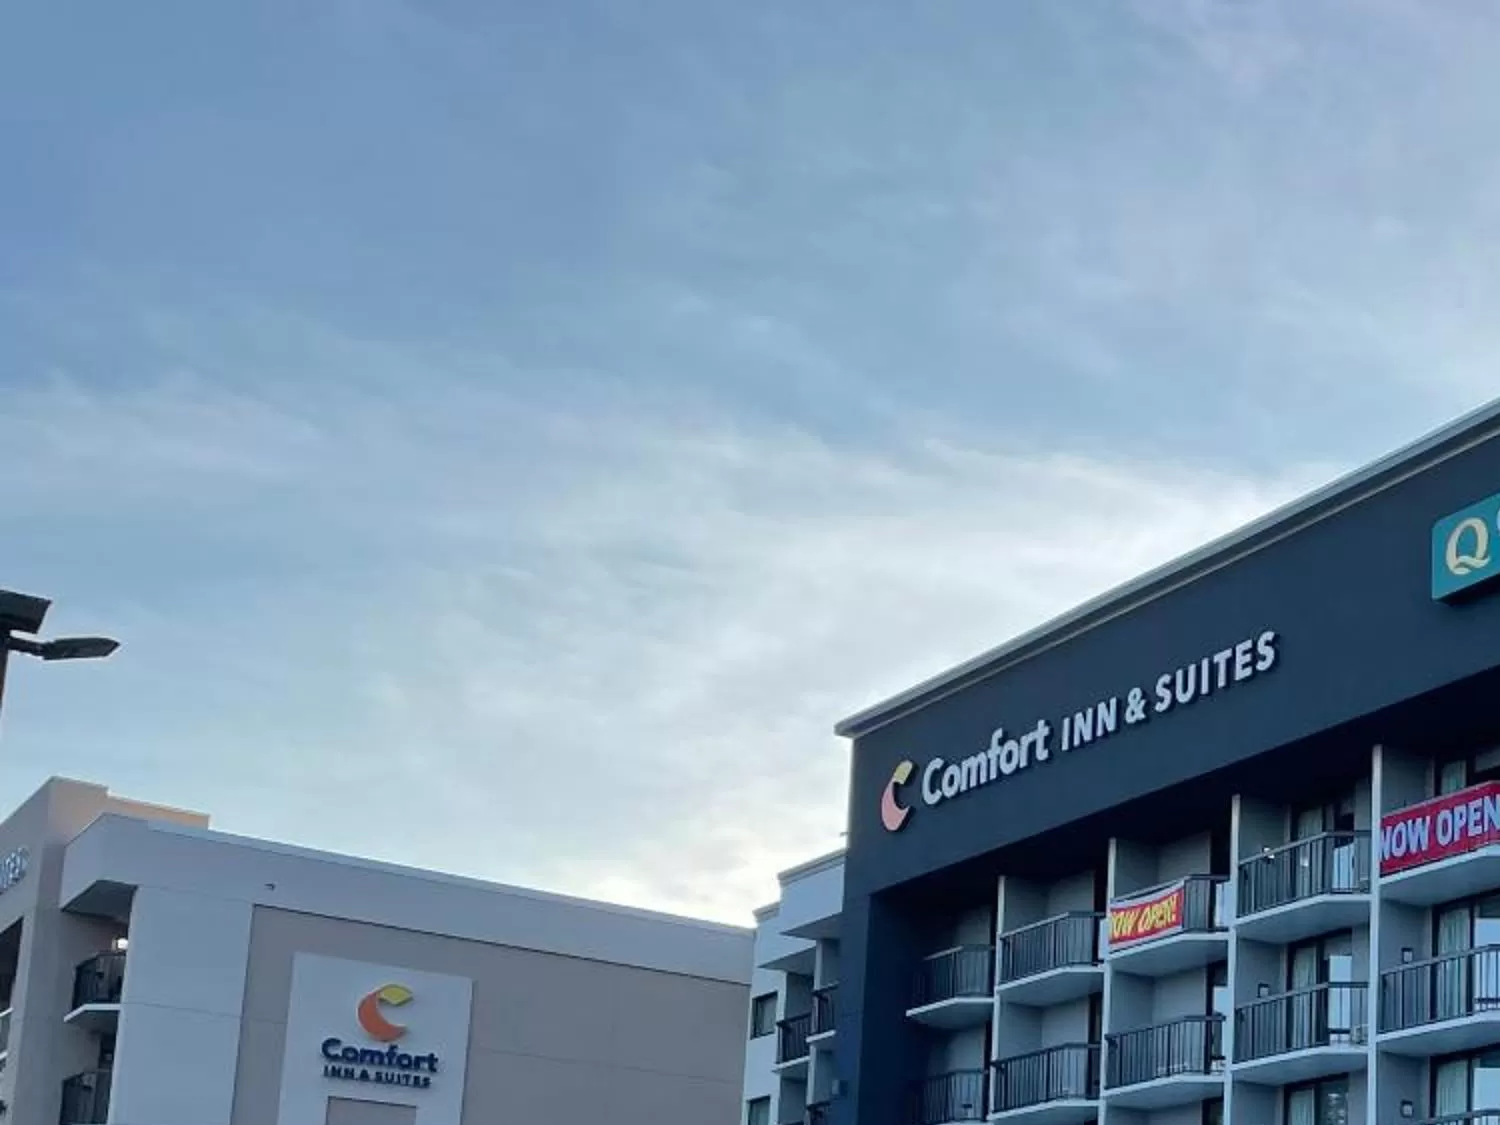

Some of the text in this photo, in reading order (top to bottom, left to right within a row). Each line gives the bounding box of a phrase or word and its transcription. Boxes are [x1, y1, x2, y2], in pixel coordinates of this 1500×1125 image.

[921, 630, 1276, 806] Comfort INN & SUITES
[1379, 815, 1430, 861] NOW
[321, 1037, 439, 1073] Comfort
[324, 1064, 354, 1080] INN
[374, 1070, 432, 1088] SUITES
